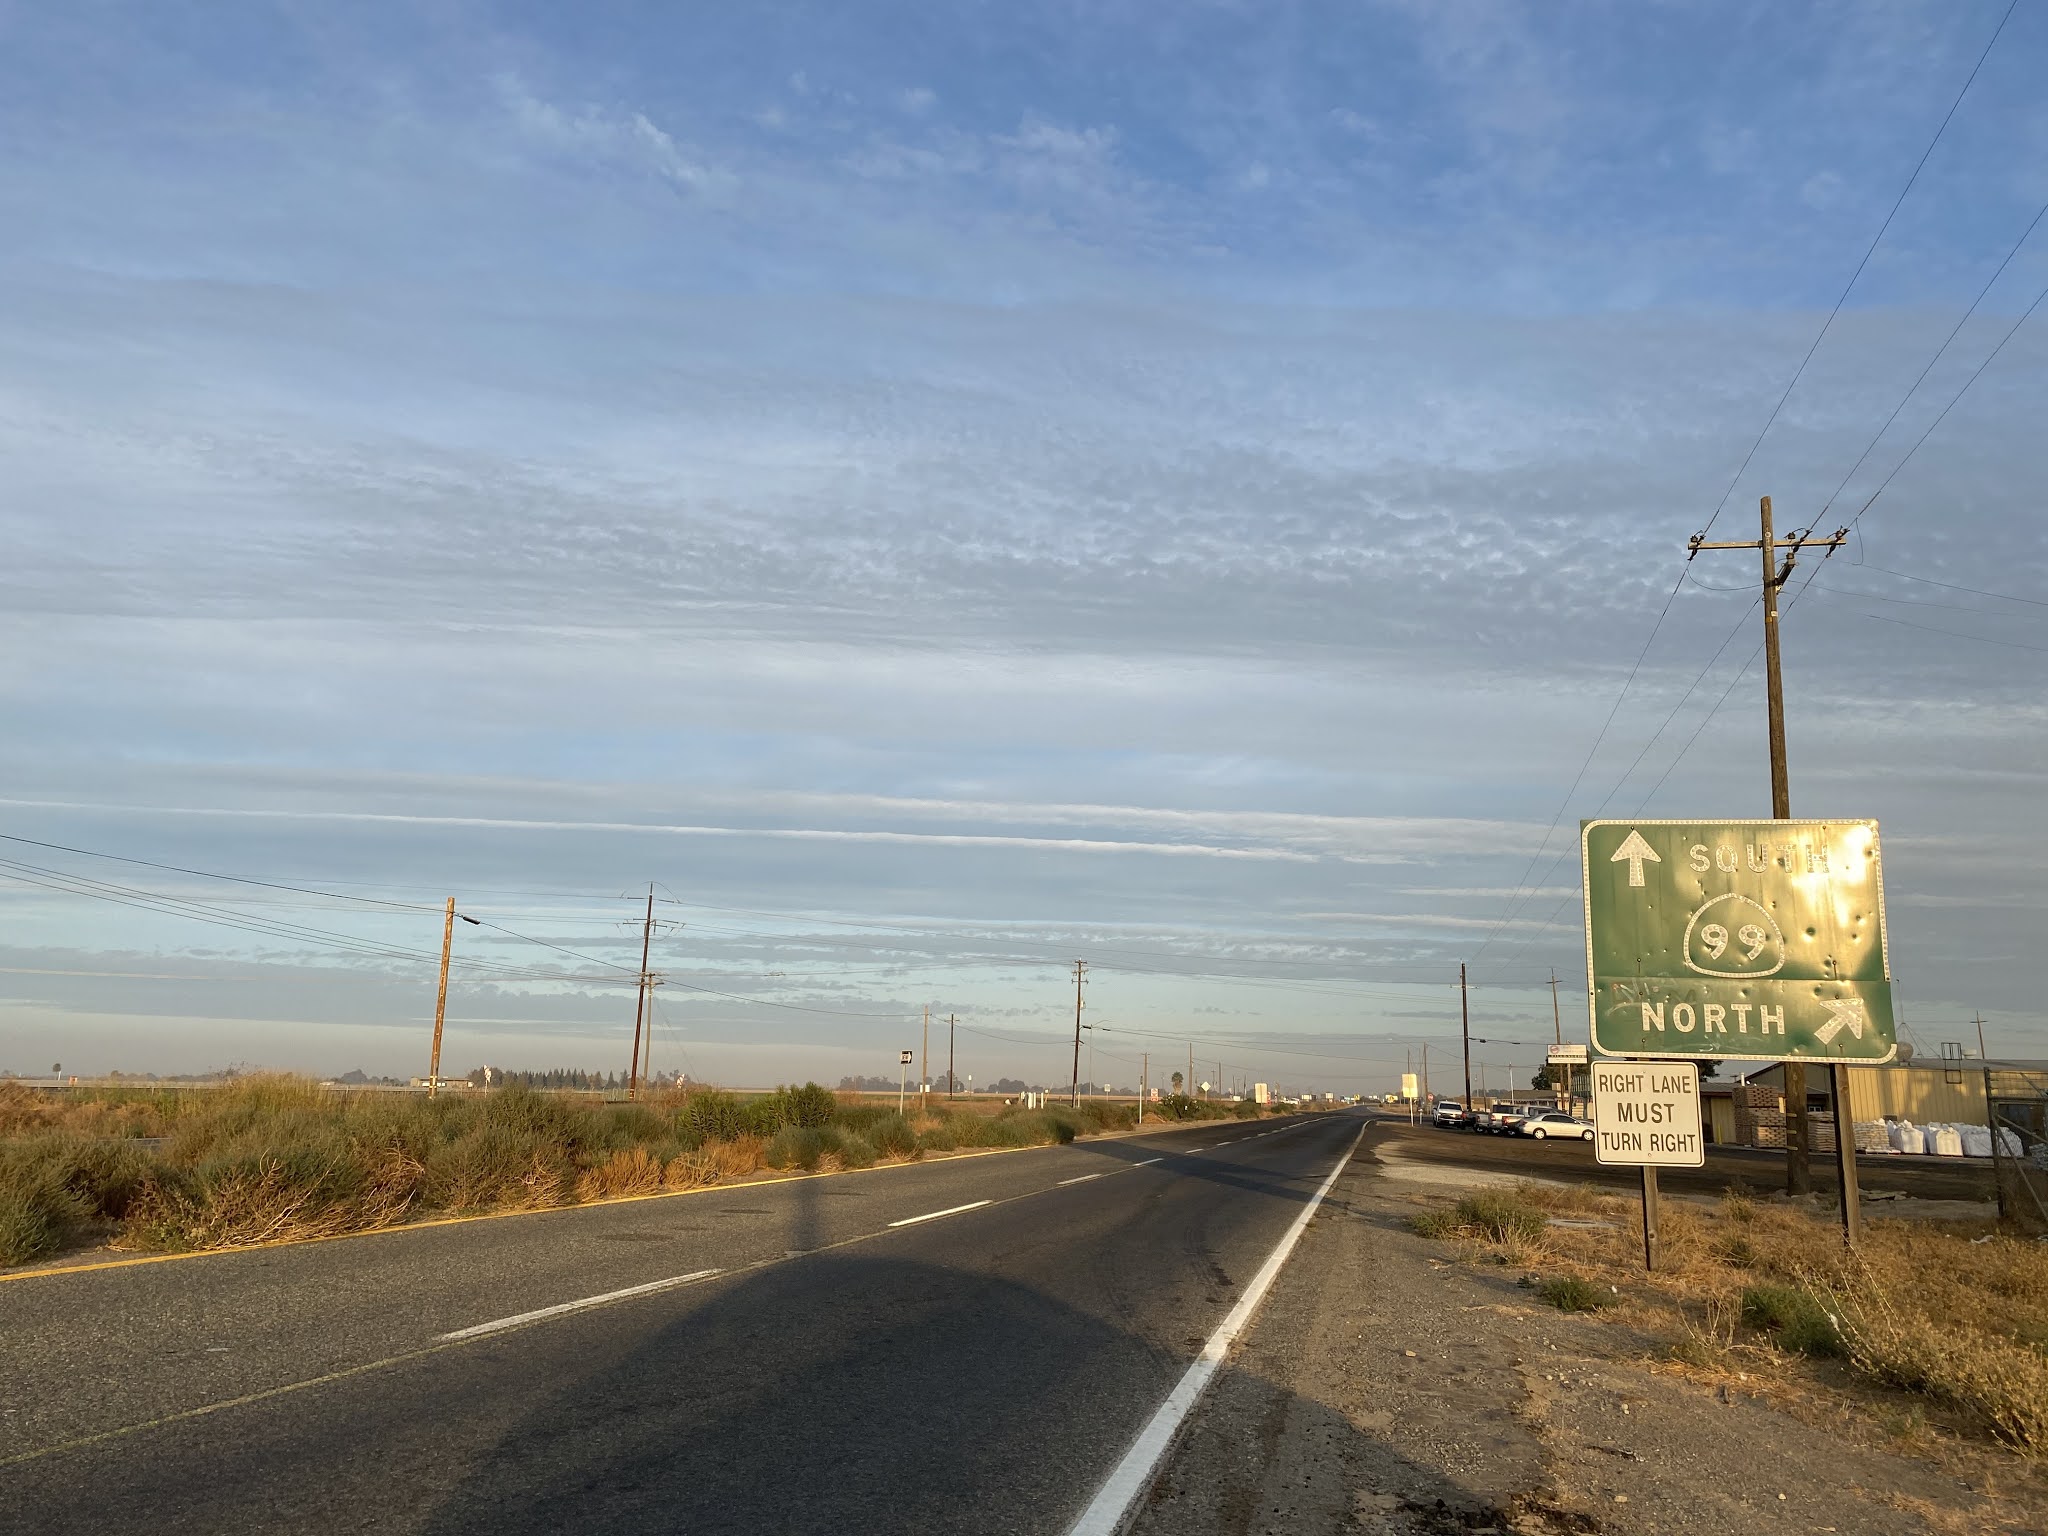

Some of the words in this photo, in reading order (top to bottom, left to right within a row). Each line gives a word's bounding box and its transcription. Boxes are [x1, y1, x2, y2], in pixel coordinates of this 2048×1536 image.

[1690, 844, 1830, 873] SOUTH
[1701, 923, 1766, 961] 99
[1641, 1002, 1785, 1034] NORTH
[1599, 1074, 1644, 1092] RIGHT
[1652, 1075, 1691, 1093] LANE
[1618, 1102, 1674, 1123] MUST
[1601, 1132, 1642, 1151] TURN
[1650, 1133, 1695, 1152] RIGHT
